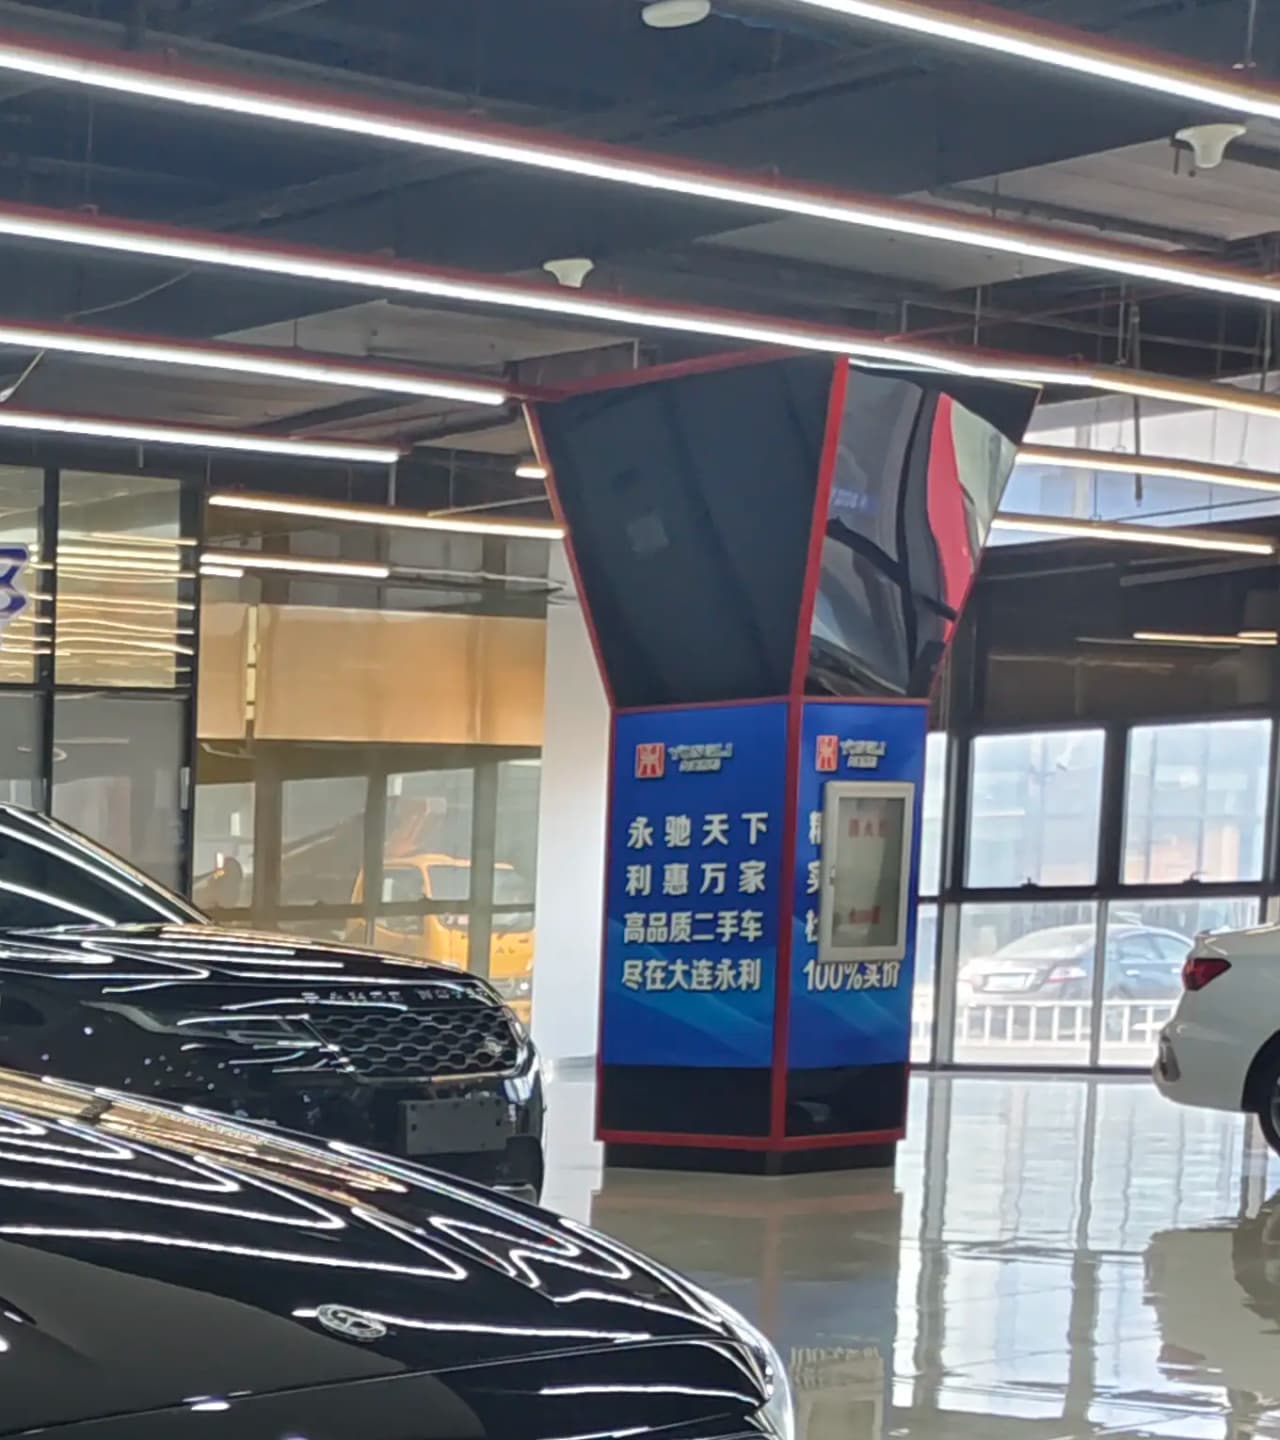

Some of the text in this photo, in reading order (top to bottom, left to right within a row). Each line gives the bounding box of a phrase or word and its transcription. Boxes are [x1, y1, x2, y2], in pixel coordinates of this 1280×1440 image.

[627, 812, 769, 848] 永驰天下
[625, 862, 767, 896] 利惠万家
[623, 910, 763, 944] 高品质二手车
[621, 957, 761, 993] 尽在大连永利
